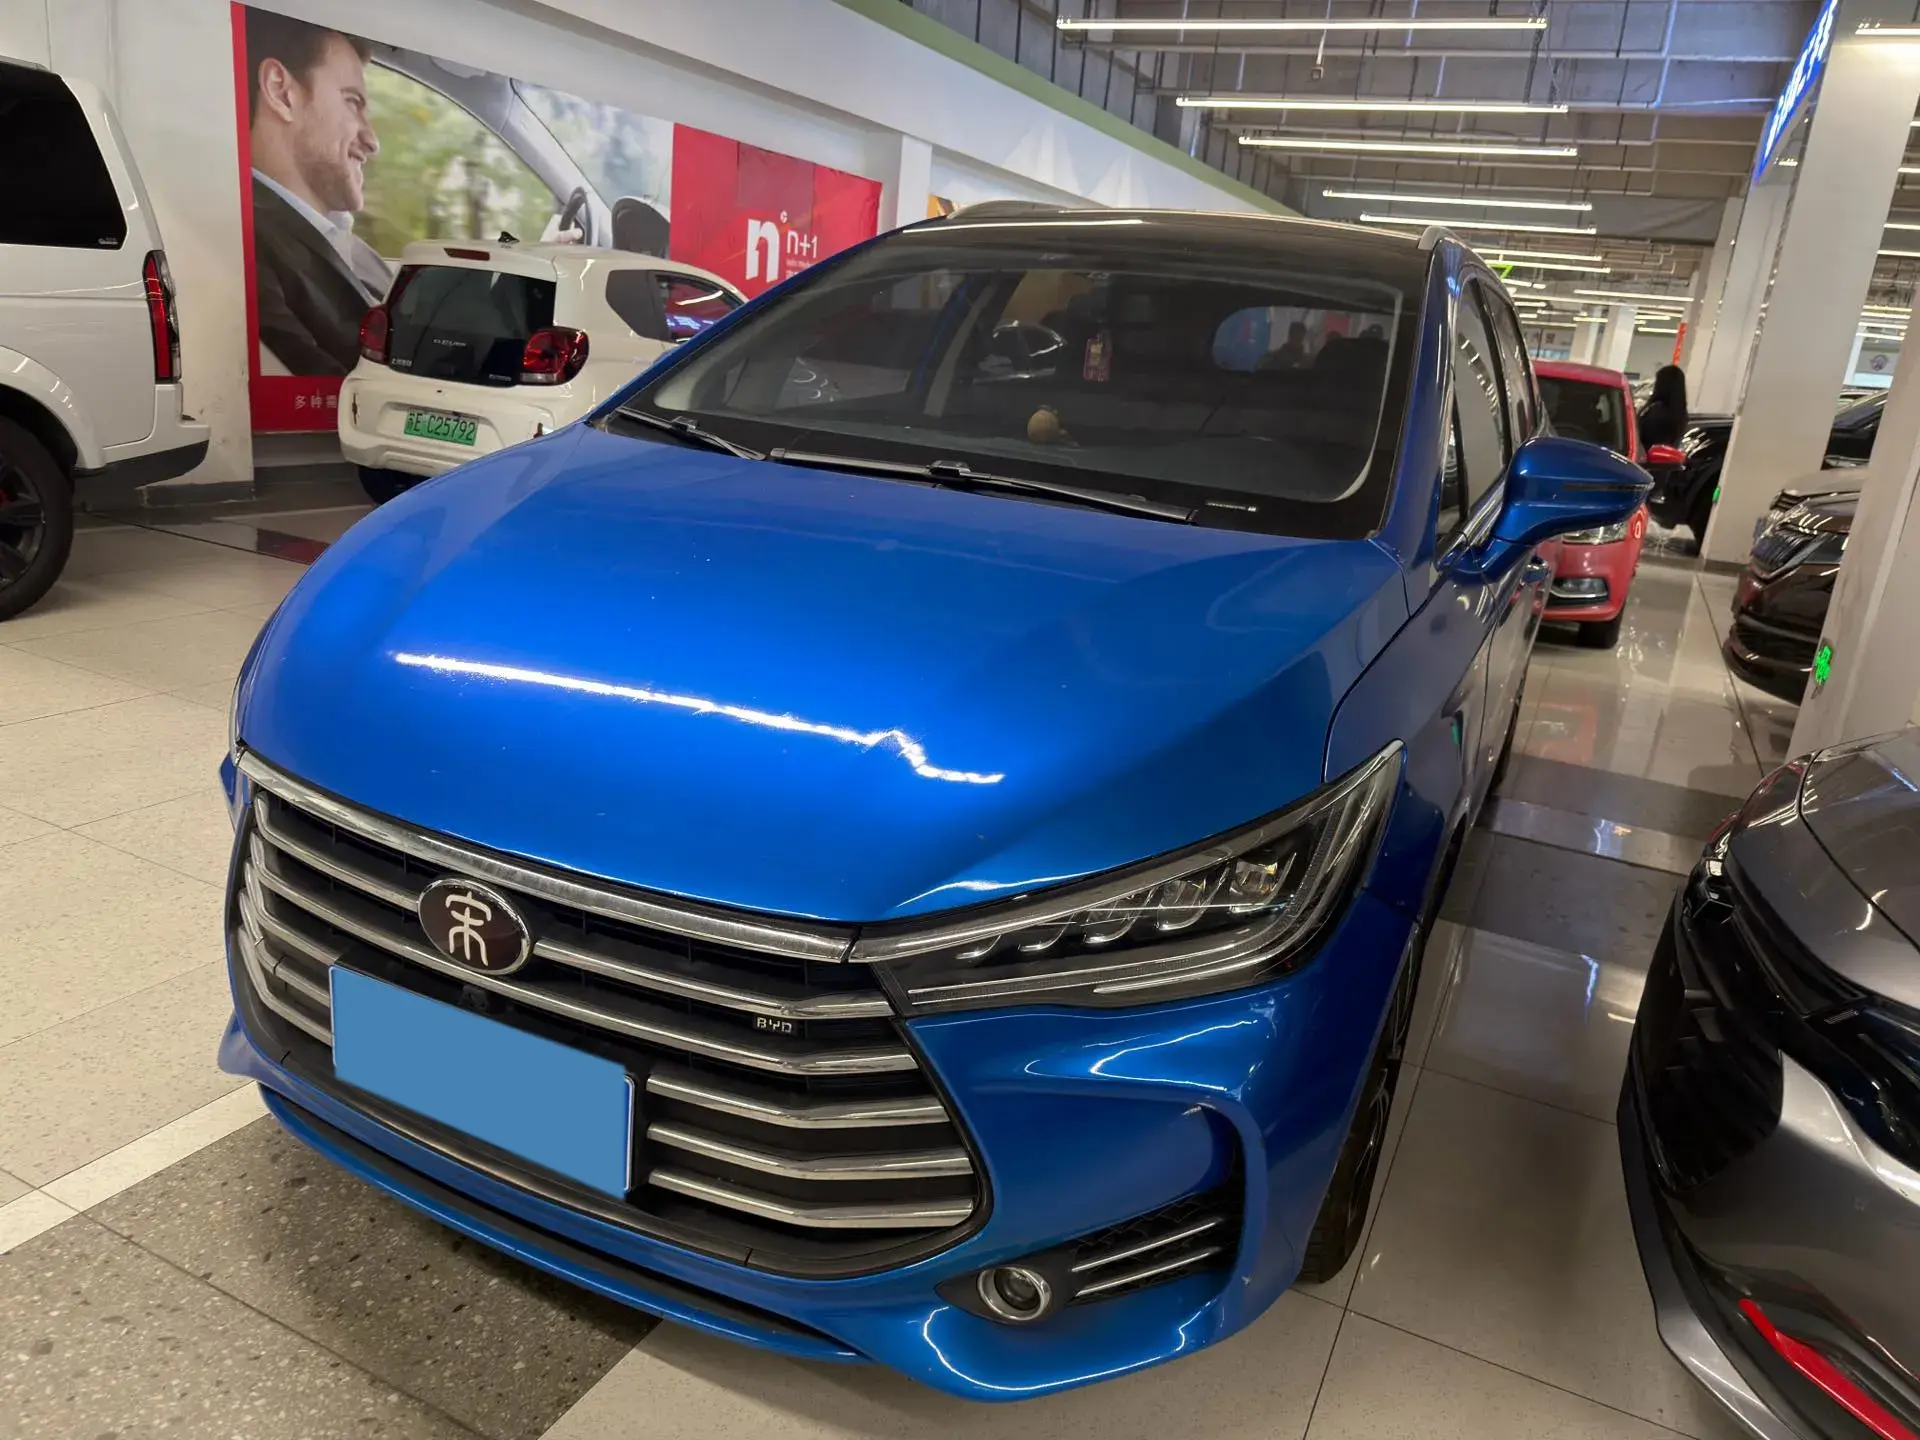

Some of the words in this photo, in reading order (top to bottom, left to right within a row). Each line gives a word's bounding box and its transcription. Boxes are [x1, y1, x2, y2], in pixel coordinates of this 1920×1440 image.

[786, 230, 818, 259] n+1
[445, 891, 492, 967] 宋
[756, 1016, 792, 1033] BYD
